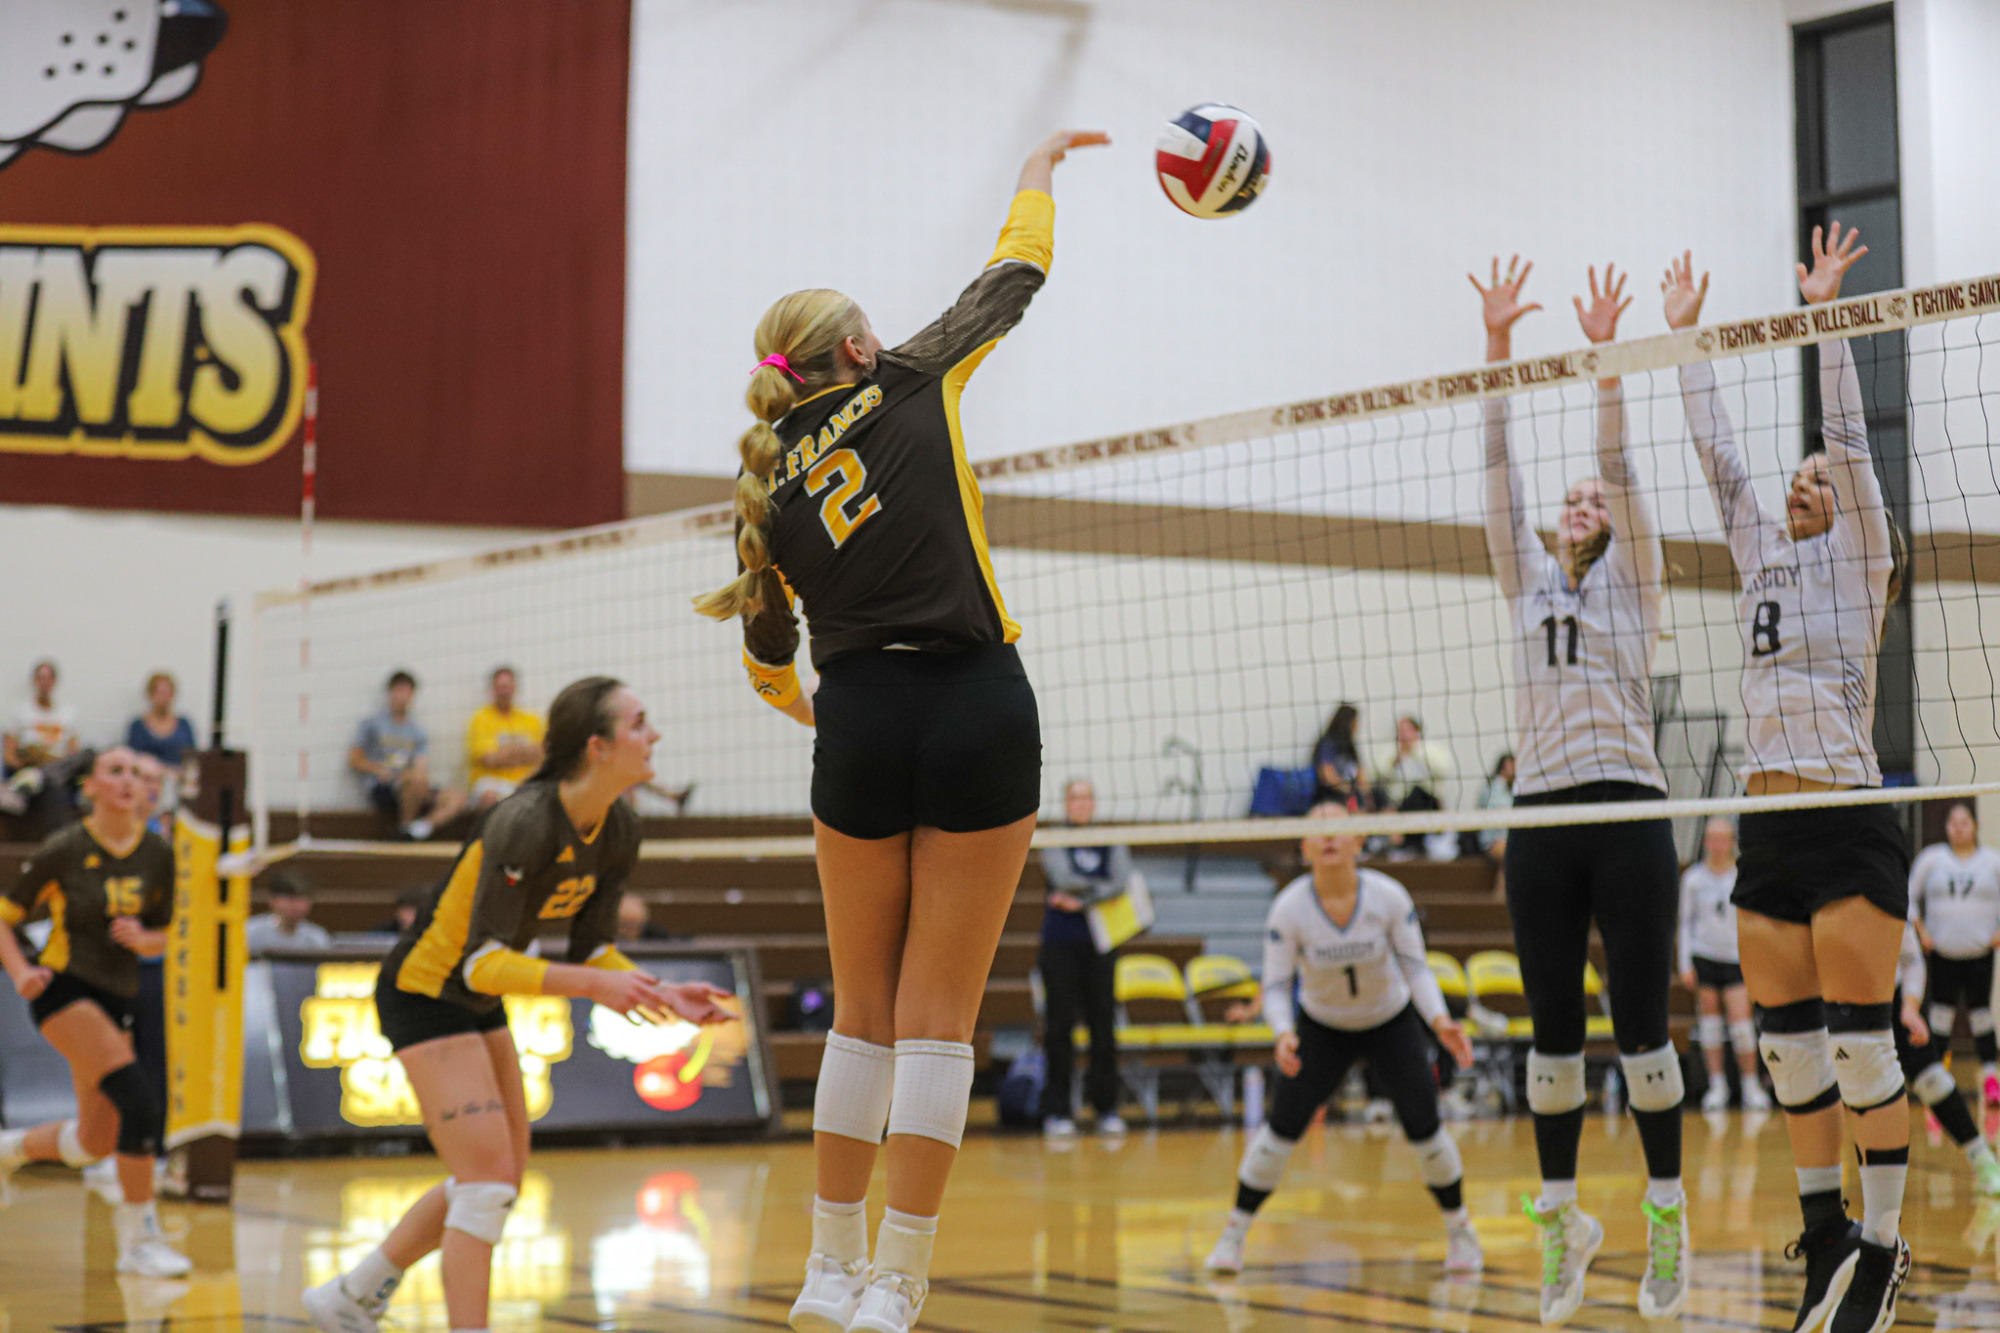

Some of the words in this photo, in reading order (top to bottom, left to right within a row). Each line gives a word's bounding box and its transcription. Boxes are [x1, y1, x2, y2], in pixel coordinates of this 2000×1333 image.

[1719, 321, 1767, 351] FIGHTING
[1770, 311, 1809, 342] SAINTS
[1811, 299, 1885, 334] VOLLEYBALL
[1912, 285, 1966, 317] FIGHTING
[1438, 371, 1480, 399] FIGHTING
[1481, 365, 1515, 391] SAINTS
[1517, 353, 1578, 385] VOLLEYBALL
[786, 383, 884, 482] FRANCIS
[803, 448, 883, 550] 2
[1541, 614, 1579, 667] 11
[1752, 601, 1782, 657] 8
[104, 876, 143, 917] 15
[538, 874, 597, 919] 22
[1344, 964, 1359, 998] 1
